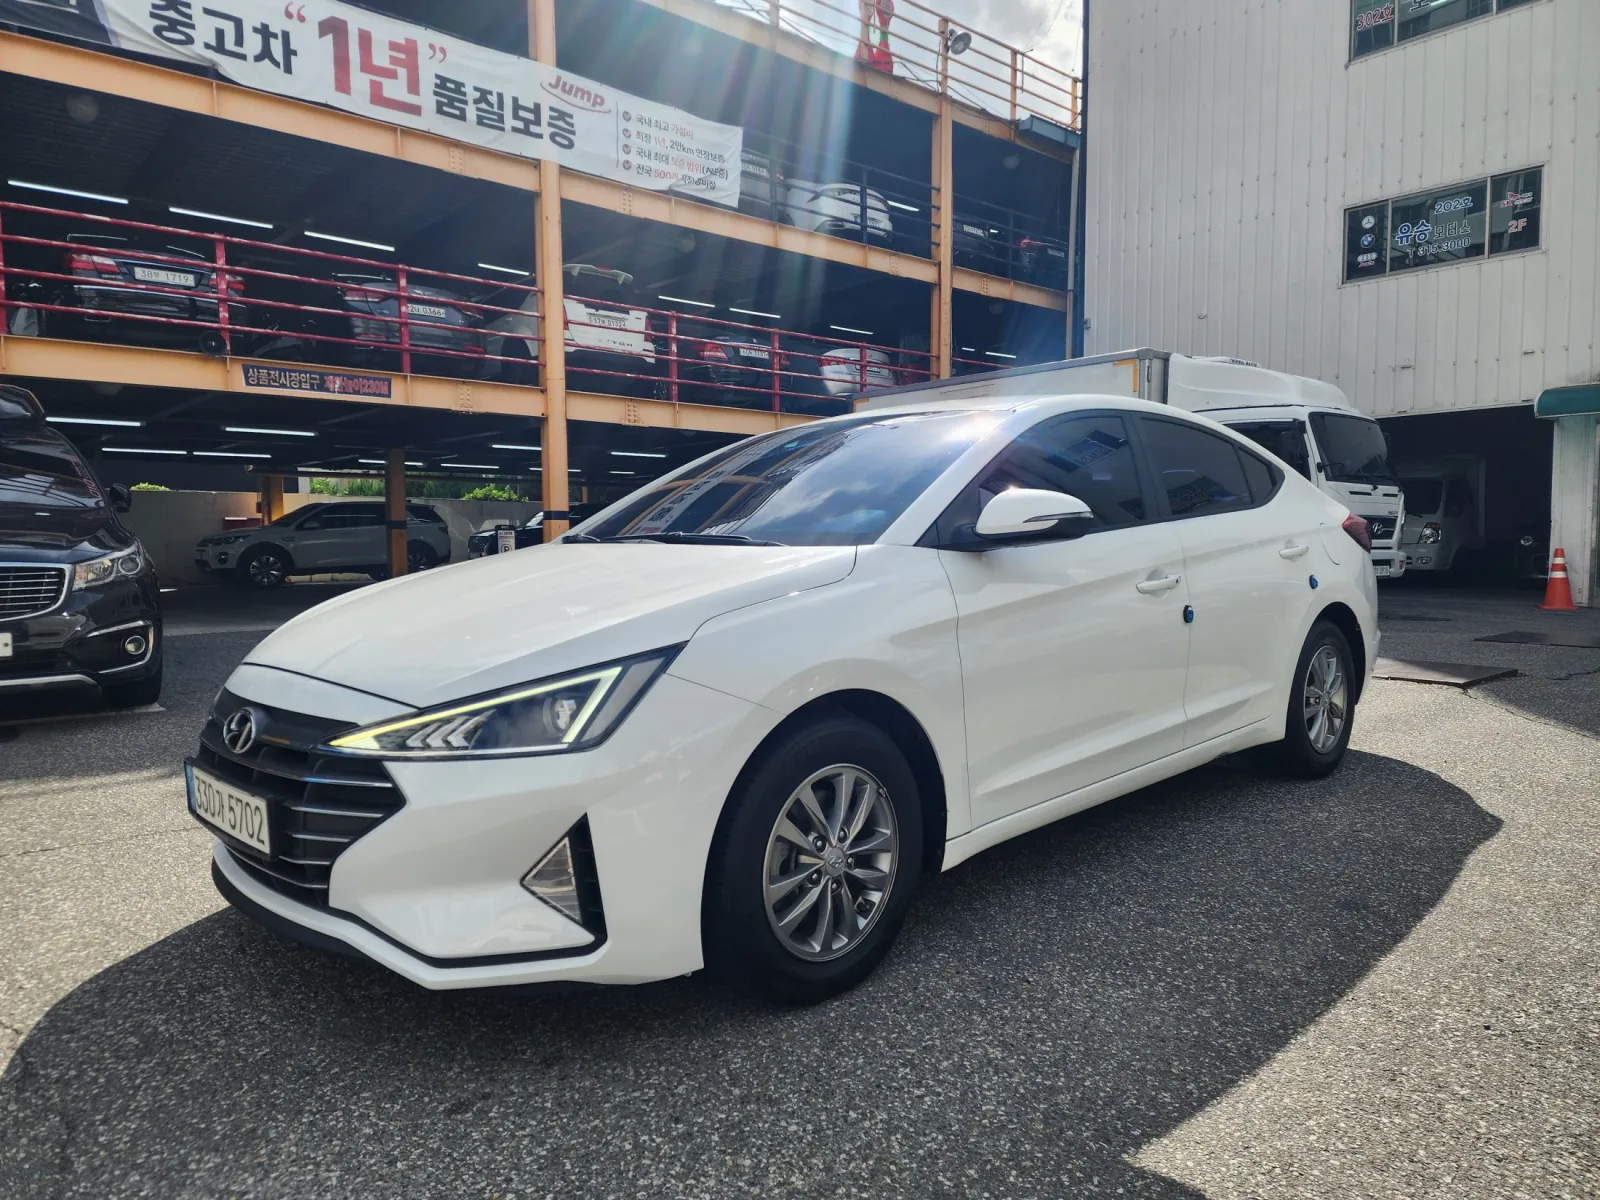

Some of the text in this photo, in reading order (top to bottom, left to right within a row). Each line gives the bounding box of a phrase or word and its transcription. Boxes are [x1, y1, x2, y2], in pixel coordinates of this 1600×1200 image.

[1356, 3, 1394, 31] 302호
[149, 0, 298, 75] 중고차
[433, 73, 576, 150] 품질보증
[548, 75, 605, 108] Jump
[636, 113, 652, 128] 국내
[654, 119, 669, 132] 최고
[636, 146, 652, 161] 국내
[636, 163, 652, 177] 전국
[1434, 196, 1474, 214] 202호
[1396, 220, 1471, 246] 유승 모터스
[1508, 218, 1527, 233] 2F
[165, 272, 190, 283] 1719
[248, 368, 321, 390] 상품전시장입구
[195, 775, 265, 846] 330가 5702
